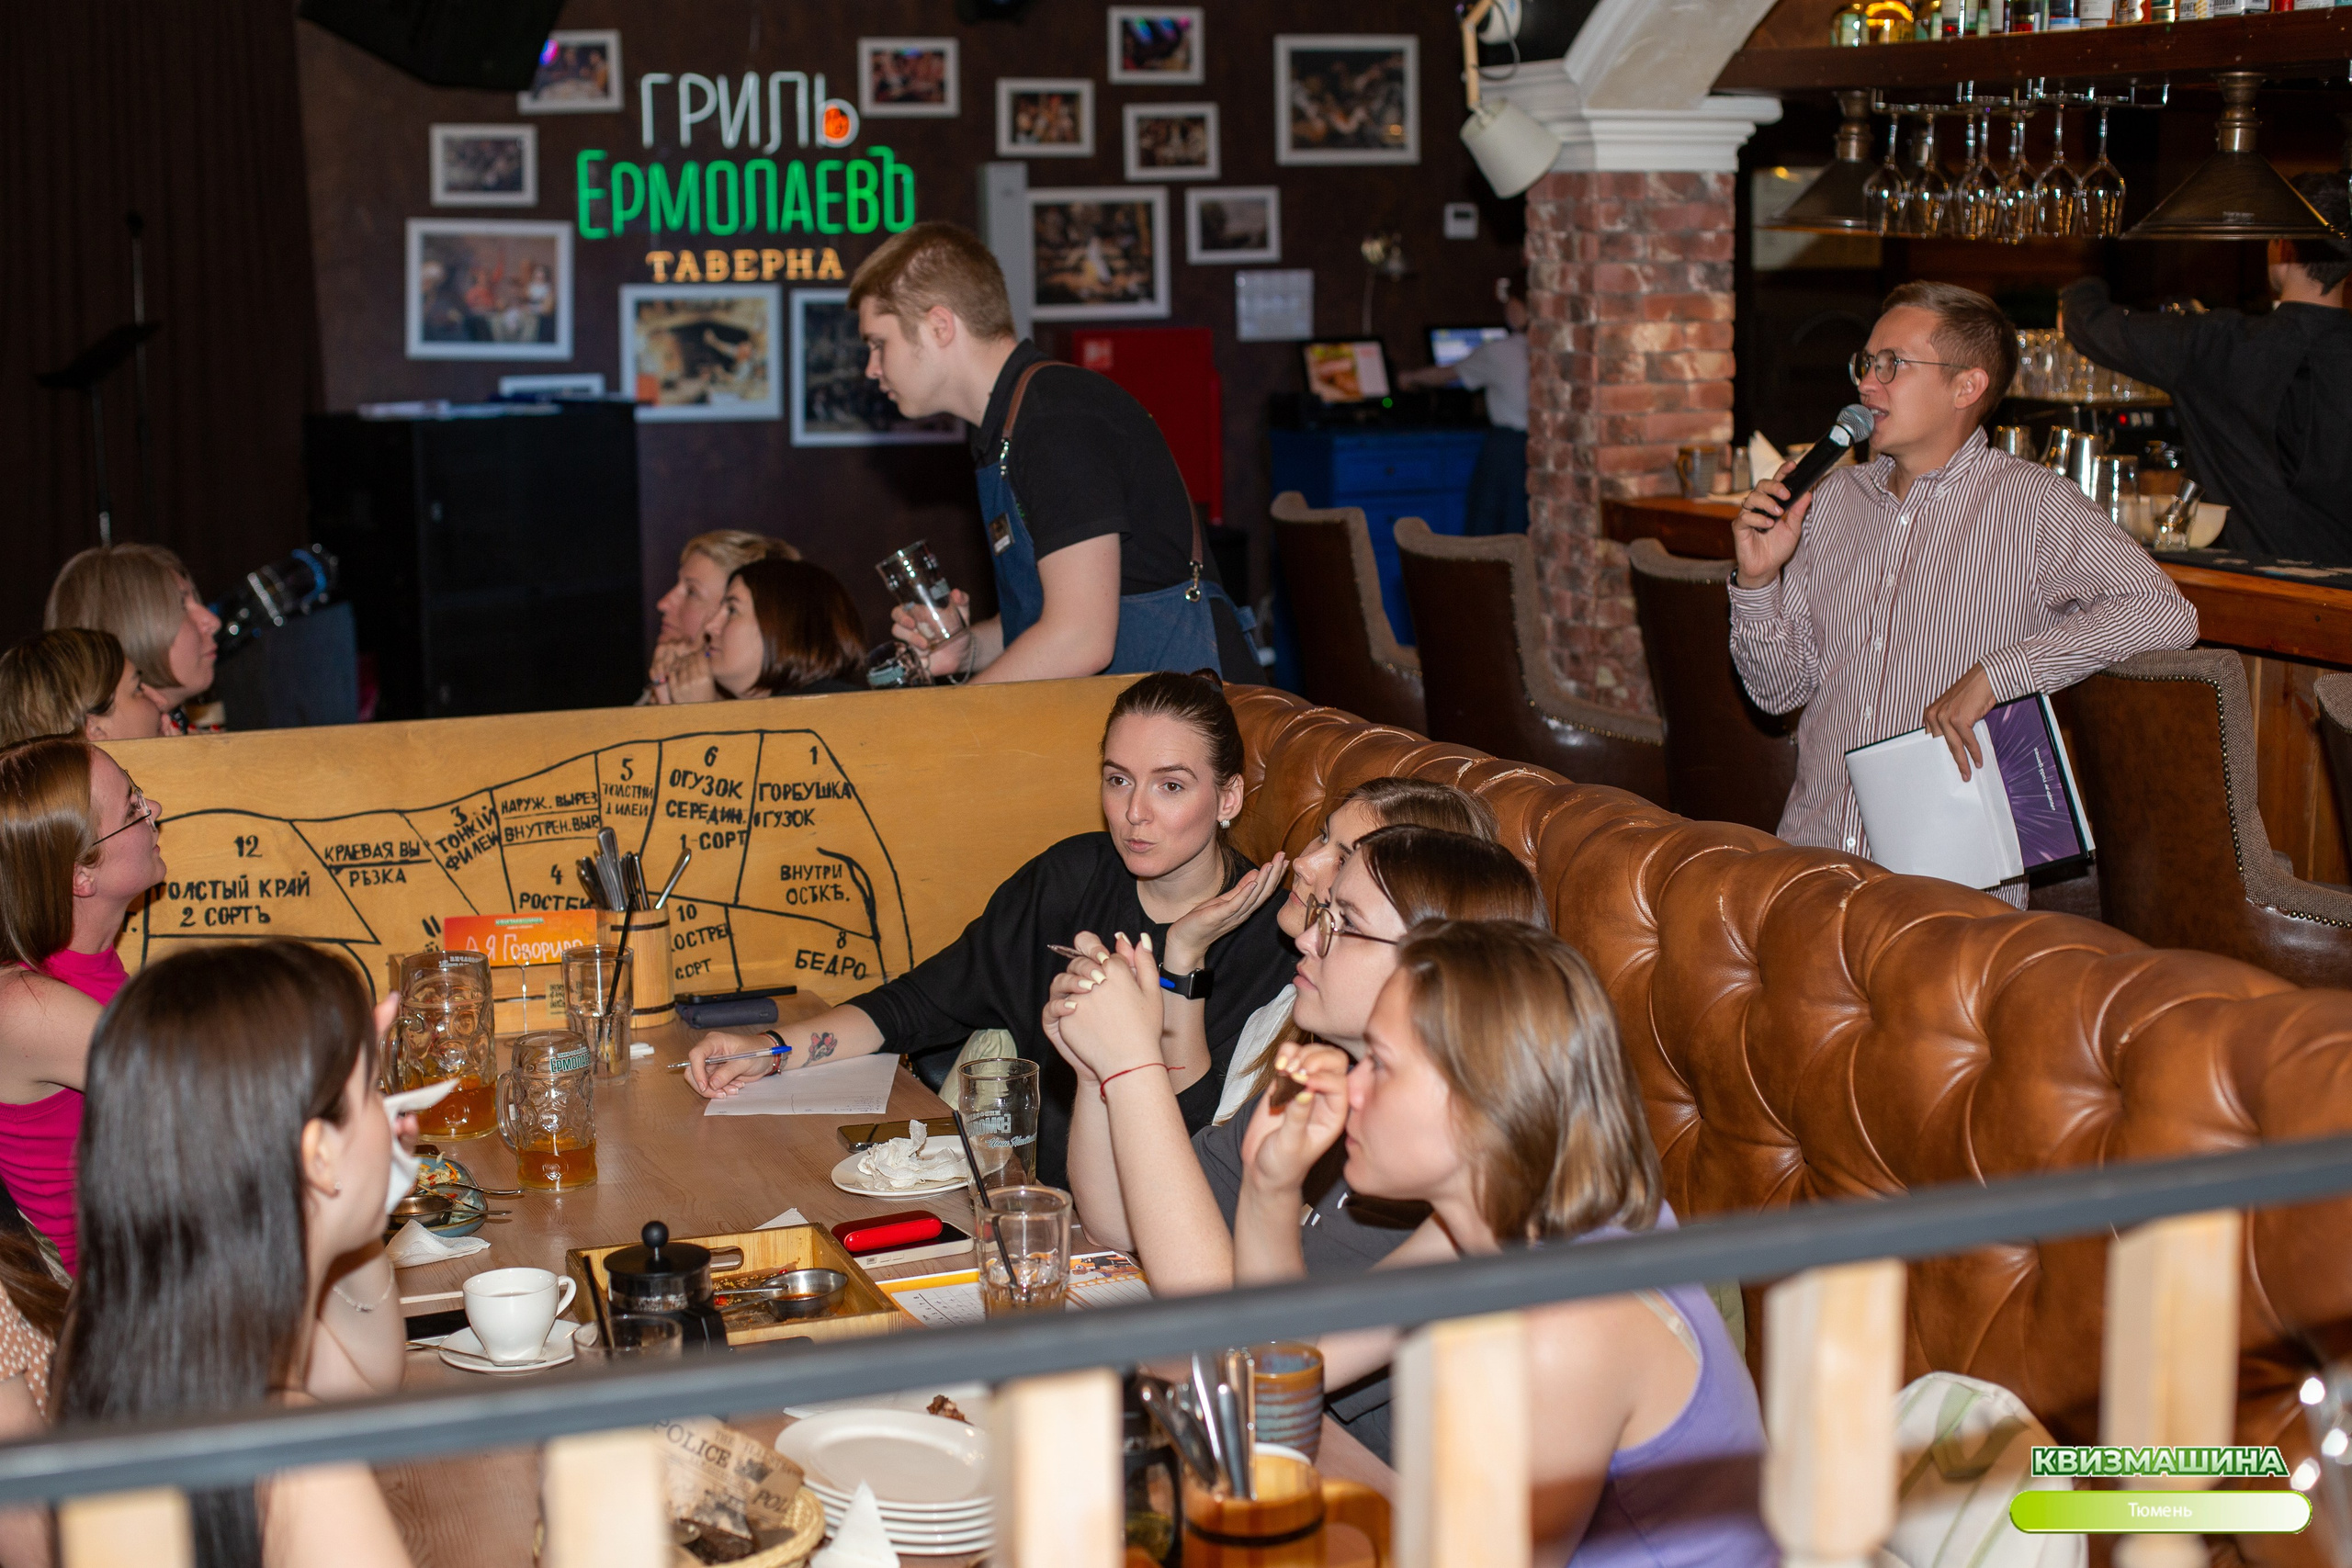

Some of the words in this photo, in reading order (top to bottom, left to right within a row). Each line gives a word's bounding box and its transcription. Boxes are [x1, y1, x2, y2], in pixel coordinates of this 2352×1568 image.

[640, 71, 861, 154] ГРИЛЬ
[576, 145, 916, 240] ЕРМОЛАЕВЪ
[645, 247, 845, 283] ТАВЕРНА
[704, 745, 718, 767] 6
[809, 745, 819, 765] 1
[620, 757, 634, 782] 5
[669, 769, 743, 800] ОГУЗОК
[759, 781, 853, 802] ГОРБУШКА
[501, 796, 552, 815] НАРУЖ.
[555, 792, 598, 807] ВЫРЕЗ
[450, 806, 468, 827] 3
[233, 834, 263, 858] 12
[400, 840, 420, 857] ВЫ
[551, 863, 562, 885] 4
[781, 864, 842, 881] ВНУТРИ
[258, 871, 311, 898] КРАЙ
[180, 907, 196, 927] 2
[204, 905, 272, 927] СОРТЪ
[677, 904, 697, 922] 10
[837, 930, 847, 949] 8
[675, 958, 712, 980] СОРТ
[795, 949, 867, 980] БЕДРО
